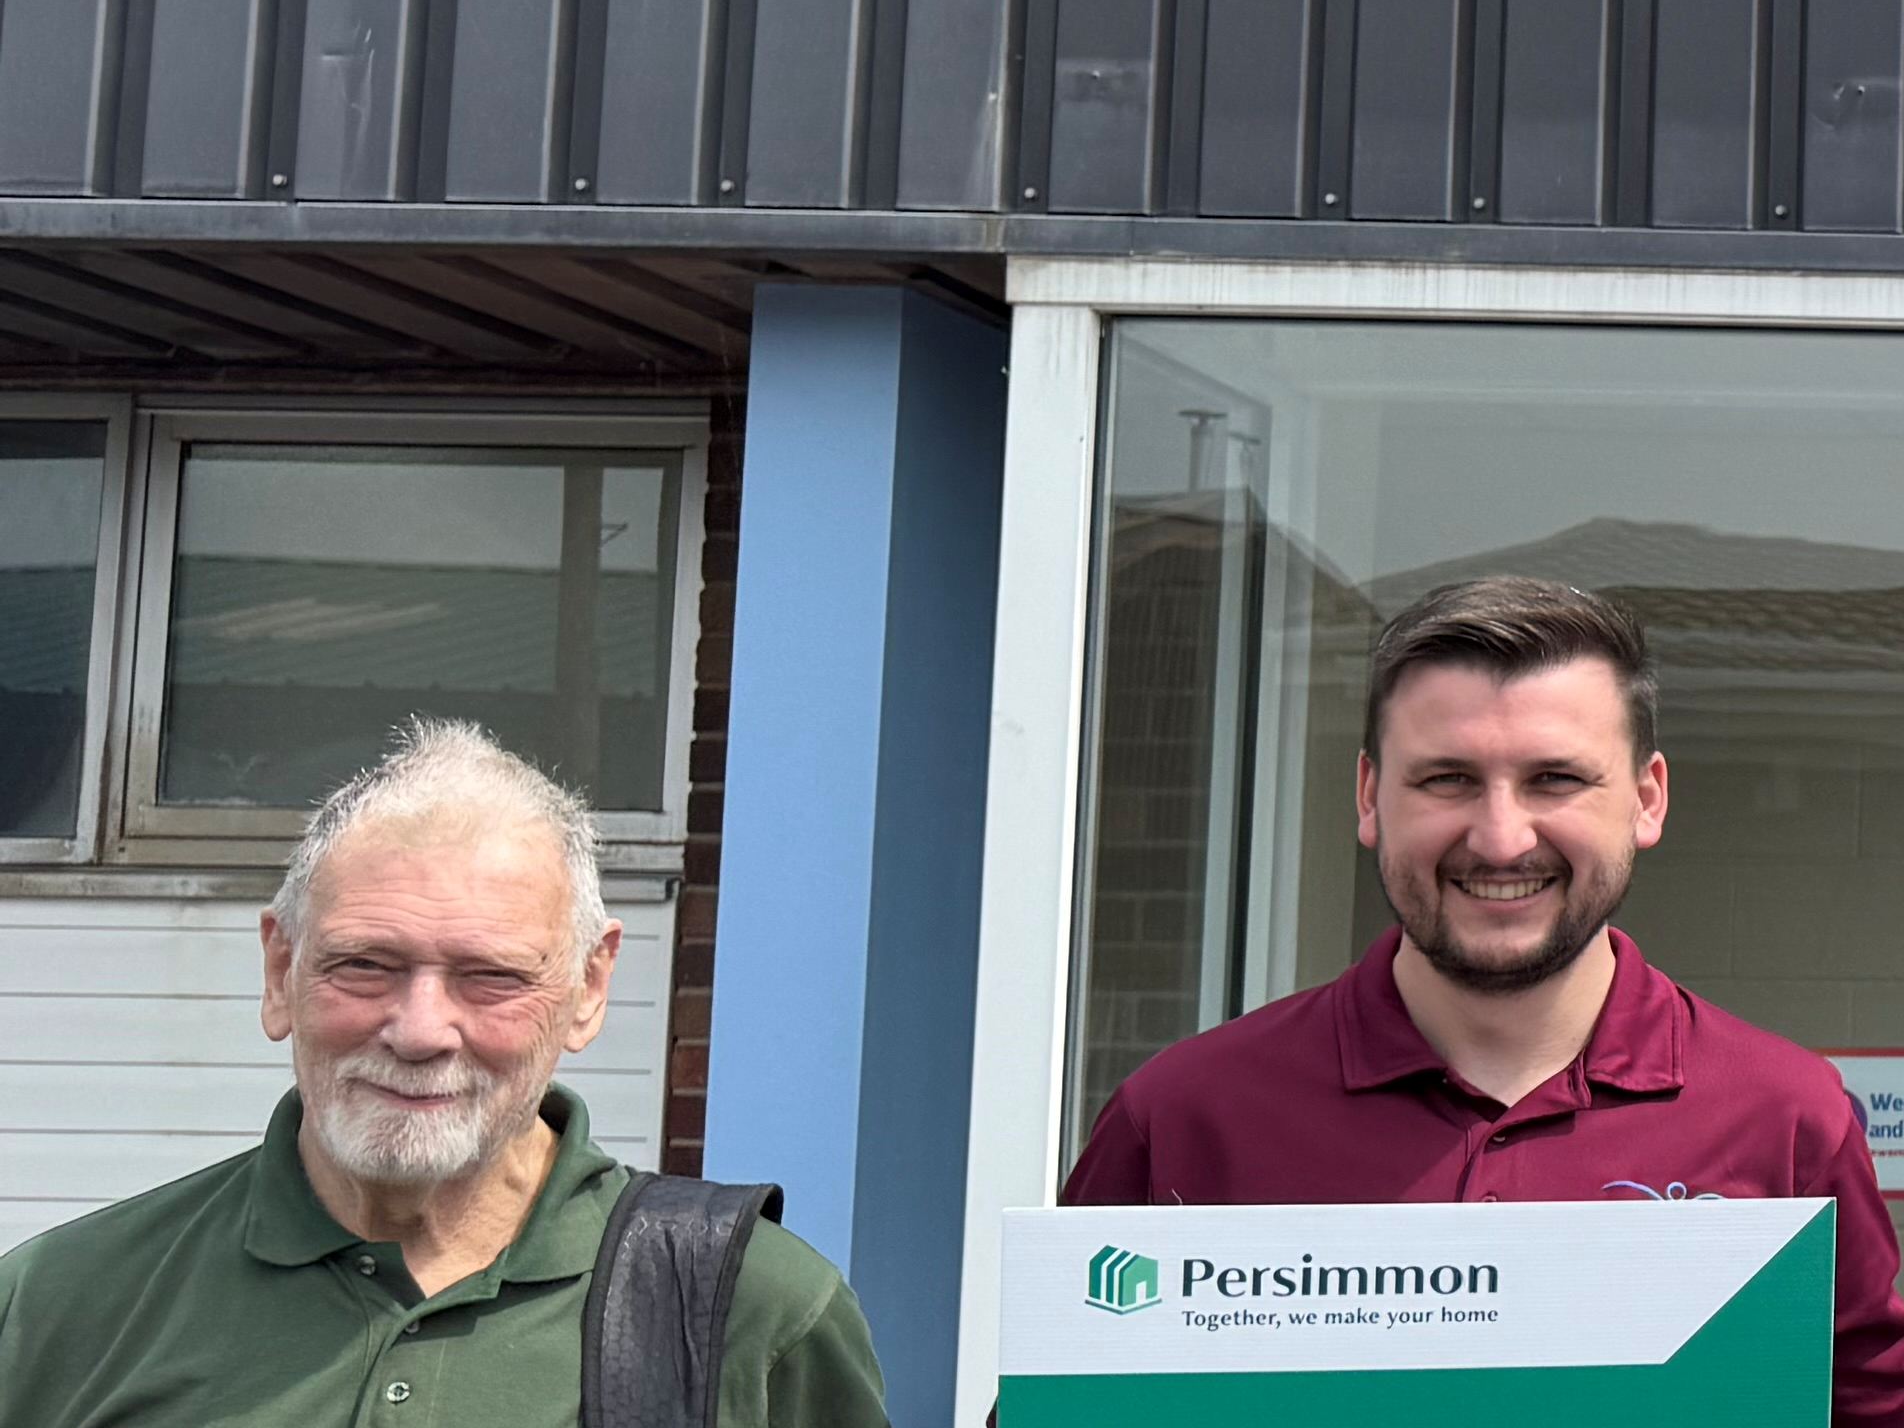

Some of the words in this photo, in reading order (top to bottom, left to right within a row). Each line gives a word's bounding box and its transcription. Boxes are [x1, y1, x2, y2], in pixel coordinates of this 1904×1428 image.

[1869, 1119, 1904, 1139] and
[1183, 1254, 1498, 1297] Persimmon
[1182, 1310, 1281, 1332] Together,
[1288, 1313, 1317, 1325] we
[1324, 1307, 1380, 1324] make
[1387, 1312, 1434, 1329] your
[1441, 1306, 1498, 1323] home
